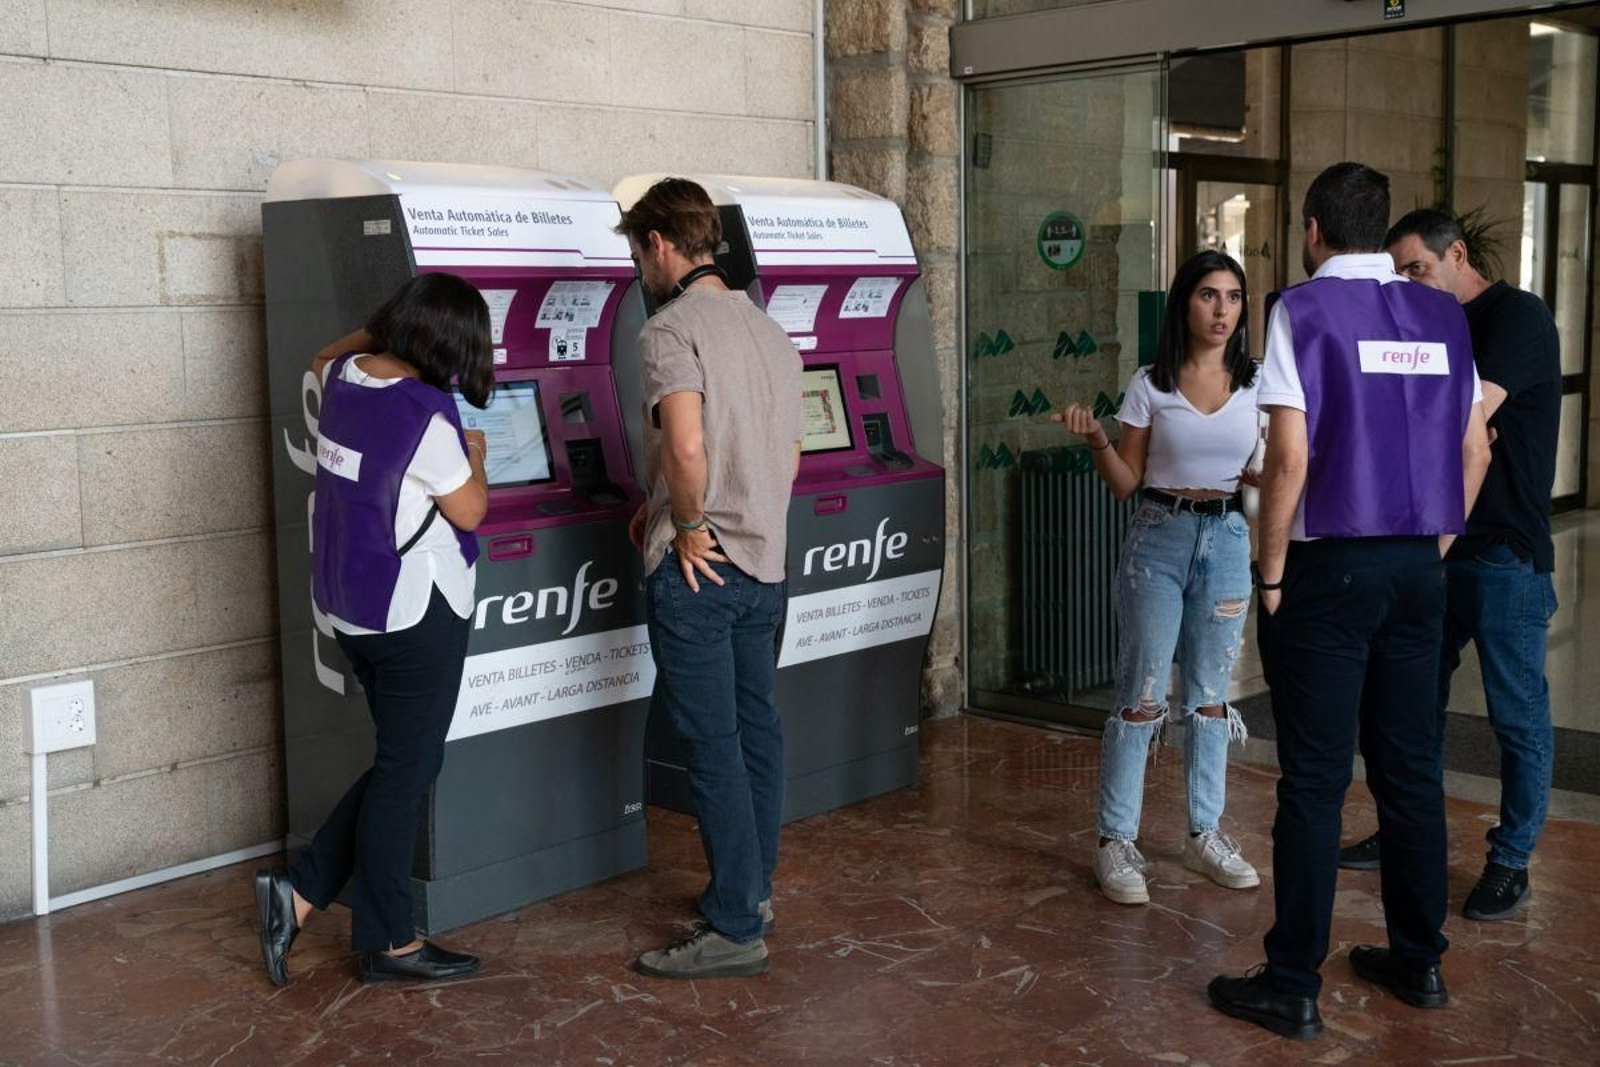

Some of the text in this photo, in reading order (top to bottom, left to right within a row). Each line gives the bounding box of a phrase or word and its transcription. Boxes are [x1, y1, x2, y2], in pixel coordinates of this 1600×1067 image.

[408, 208, 573, 225] Venta Automática de Billetes
[413, 225, 509, 237] Automatic Ticket Sales
[748, 216, 868, 229] Venta Automática de Billetes
[753, 231, 785, 240] Automatic
[788, 232, 805, 240] Ticket
[573, 342, 578, 352] 5
[1382, 345, 1430, 371] renfe
[803, 517, 908, 581] renfe
[474, 560, 618, 635] renfe
[796, 608, 824, 624] VENTA
[826, 600, 861, 619] BILLETES
[867, 596, 895, 610] VENDA
[900, 587, 930, 603] TICKETS
[796, 635, 813, 649] AVE
[819, 627, 847, 644] AVANT
[853, 621, 880, 637] LARGA
[881, 612, 922, 631] DISTANCIA
[468, 671, 505, 689] VENTA
[508, 660, 556, 680] BILLETES
[565, 652, 601, 670] VENDA
[609, 642, 651, 661] TICKETS
[470, 702, 492, 718] AVE
[501, 692, 540, 711] AVANT
[547, 685, 583, 702] LARGA
[586, 672, 639, 693] DISTANCIA
